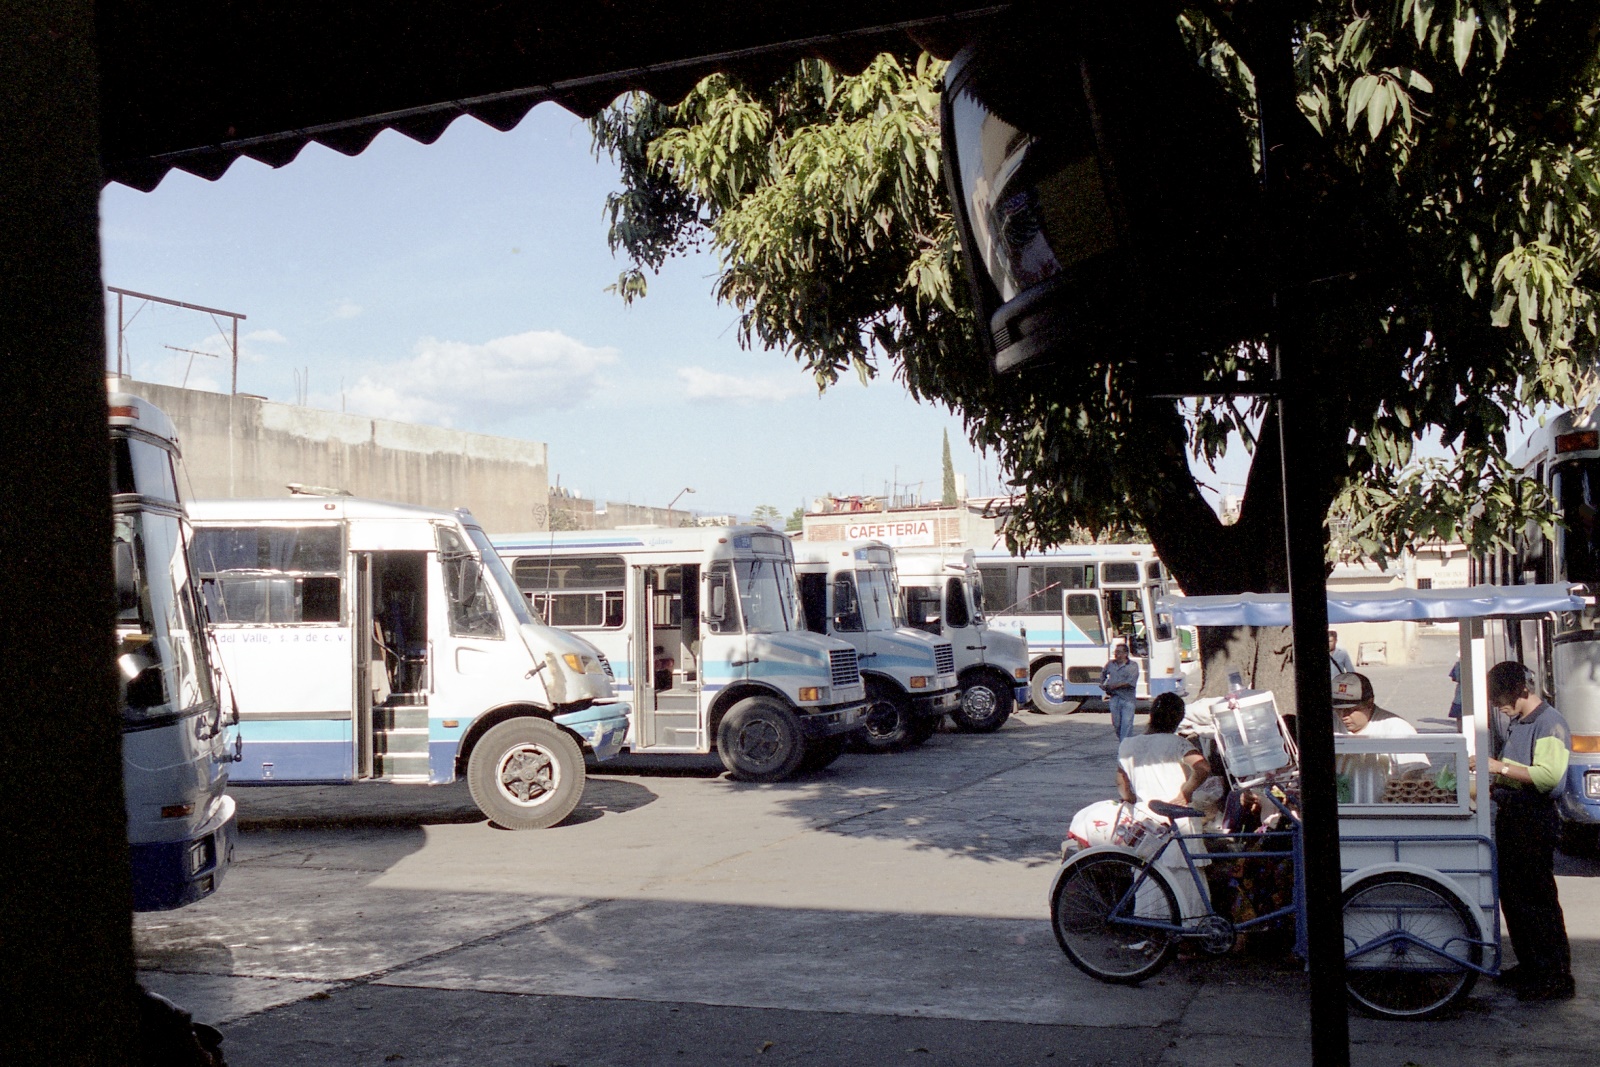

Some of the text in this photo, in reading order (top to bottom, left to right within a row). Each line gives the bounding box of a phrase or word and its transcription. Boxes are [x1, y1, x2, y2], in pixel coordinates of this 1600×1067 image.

[849, 522, 929, 539] CAFETERIA
[220, 633, 235, 643] del
[305, 633, 318, 642] de
